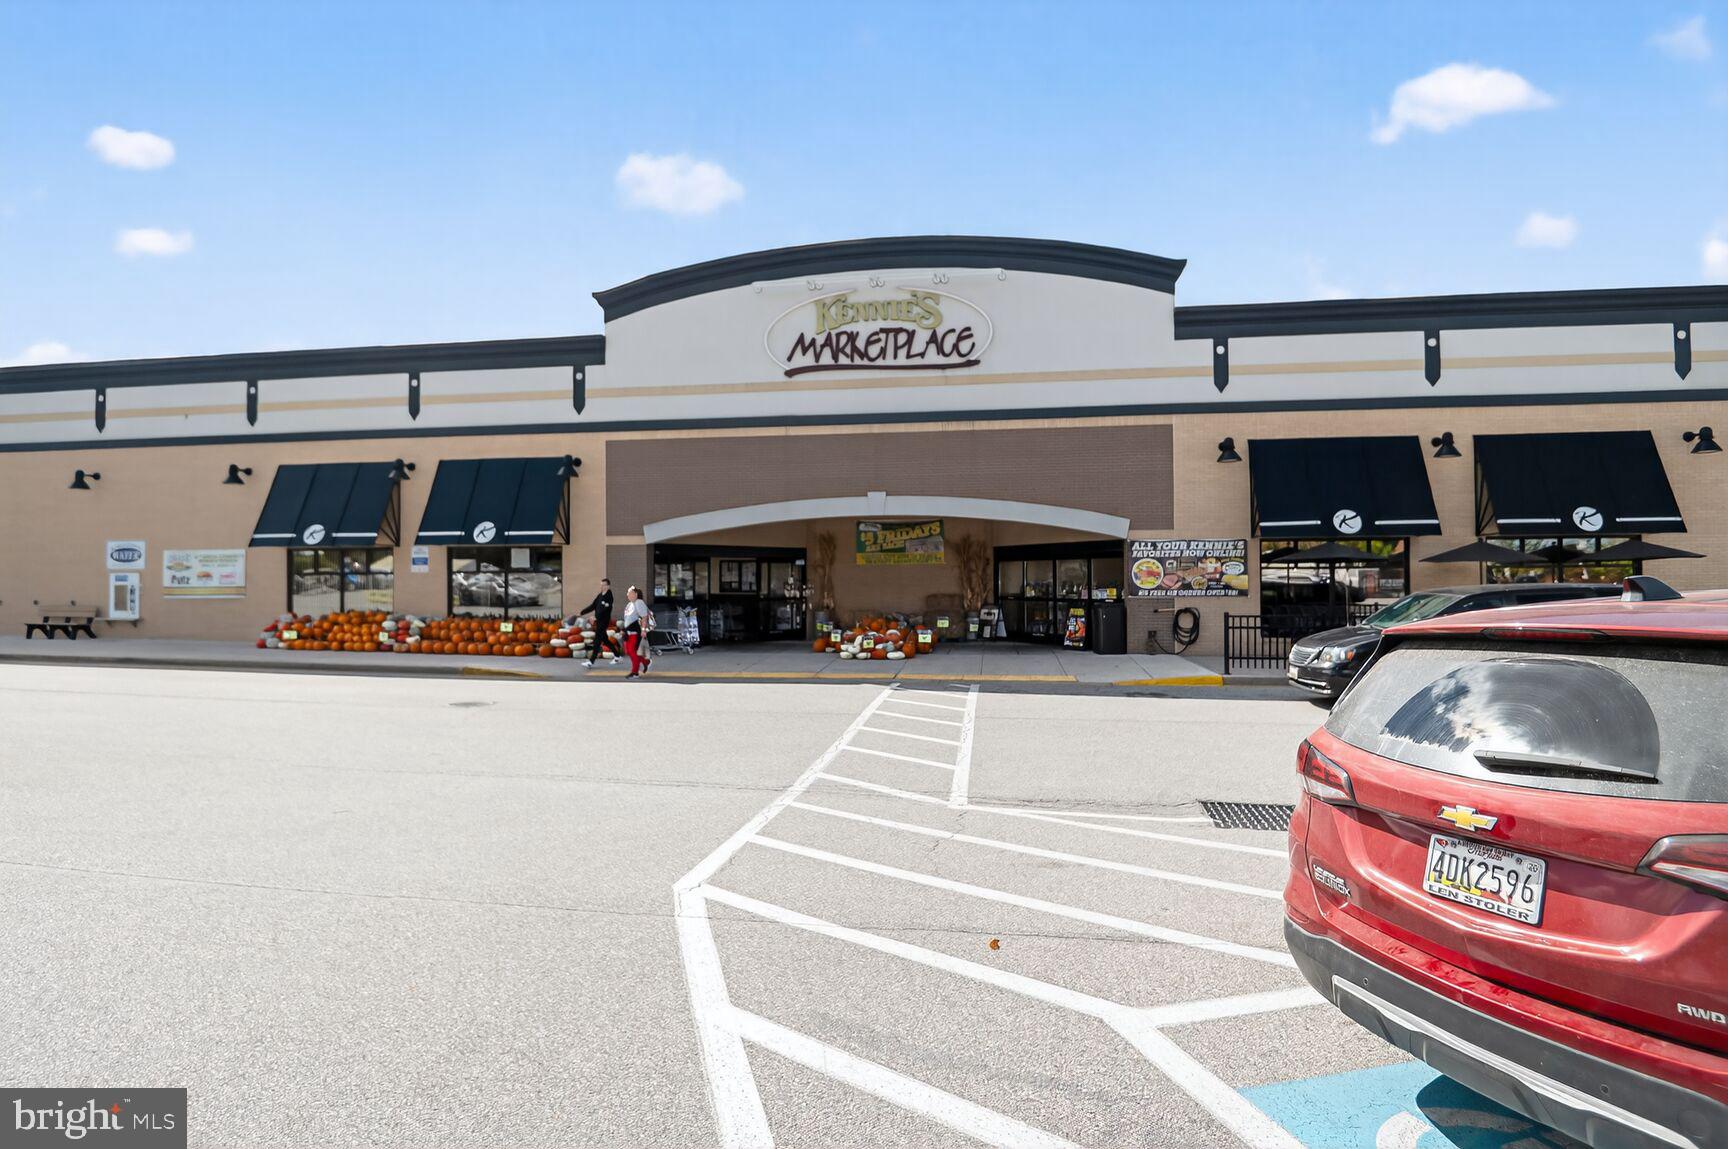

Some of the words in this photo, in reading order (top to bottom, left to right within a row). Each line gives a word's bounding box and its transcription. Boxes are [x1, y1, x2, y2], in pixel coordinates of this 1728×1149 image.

[816, 291, 943, 335] KENNIE'S
[786, 327, 976, 364] MARKETPLACE
[1132, 542, 1154, 550] ALL
[1156, 541, 1187, 550] YOUR
[1182, 550, 1205, 558] NOW
[1432, 851, 1535, 904] 4DK2596
[1428, 884, 1459, 899] LEN
[1464, 895, 1530, 921] STOLER
[1677, 1002, 1726, 1024] AWD
